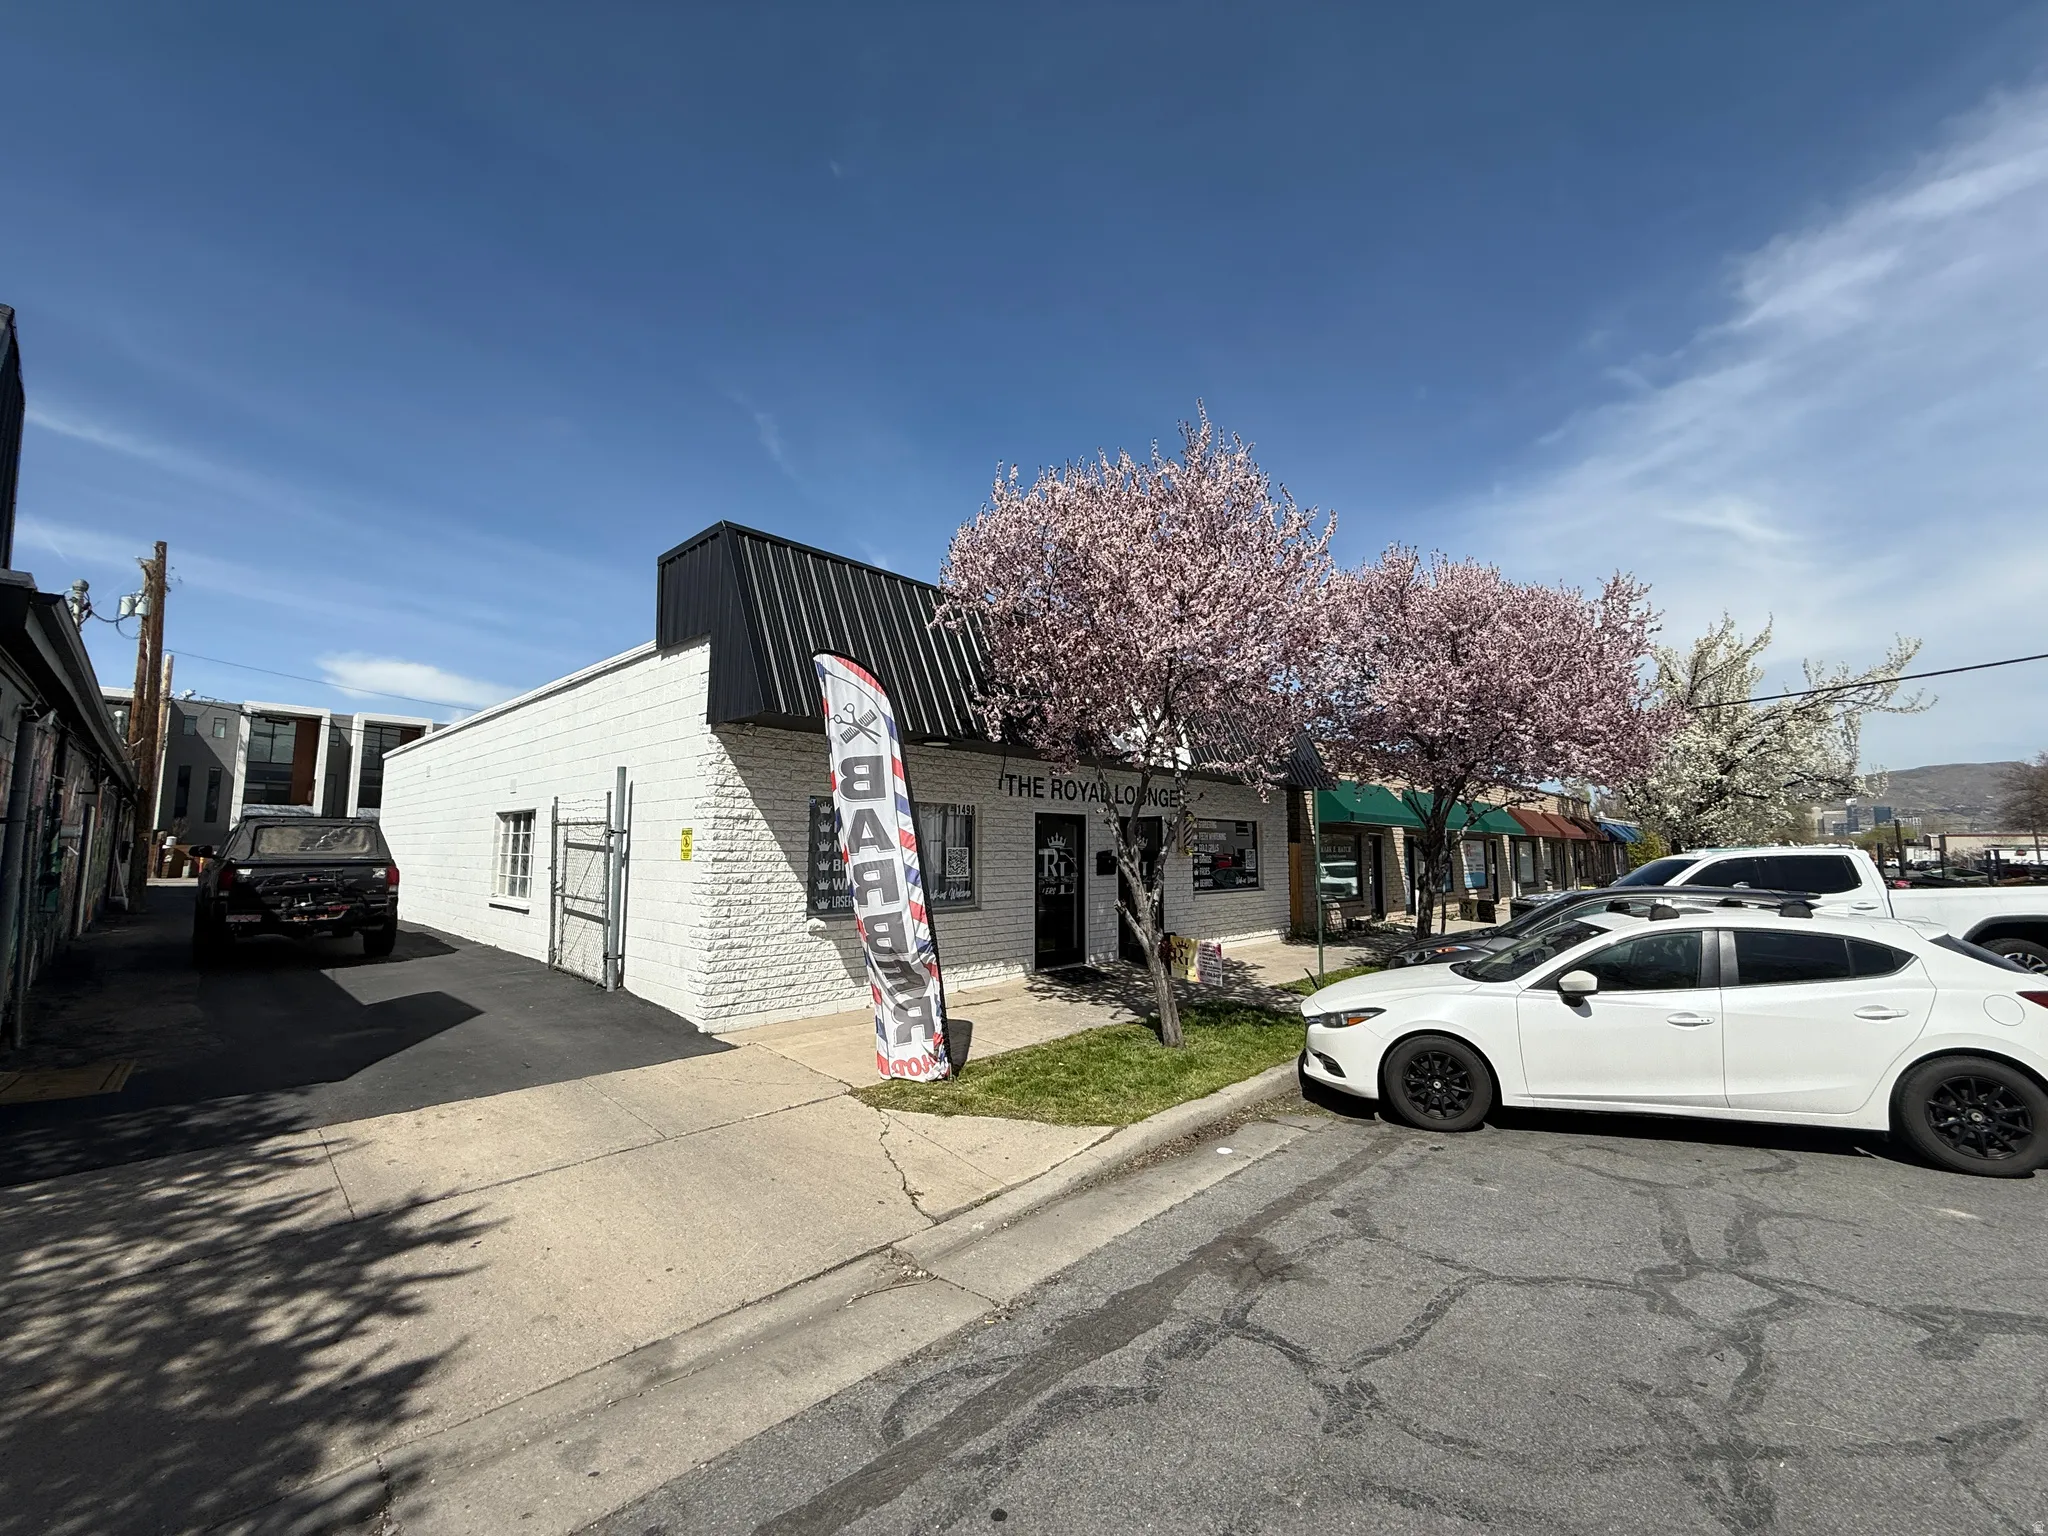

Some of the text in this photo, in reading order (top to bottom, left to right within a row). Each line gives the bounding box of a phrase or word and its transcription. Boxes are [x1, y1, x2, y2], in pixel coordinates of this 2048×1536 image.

[1004, 773, 1045, 799] THE
[1051, 778, 1108, 803] ROYAL
[956, 804, 976, 816] 1498
